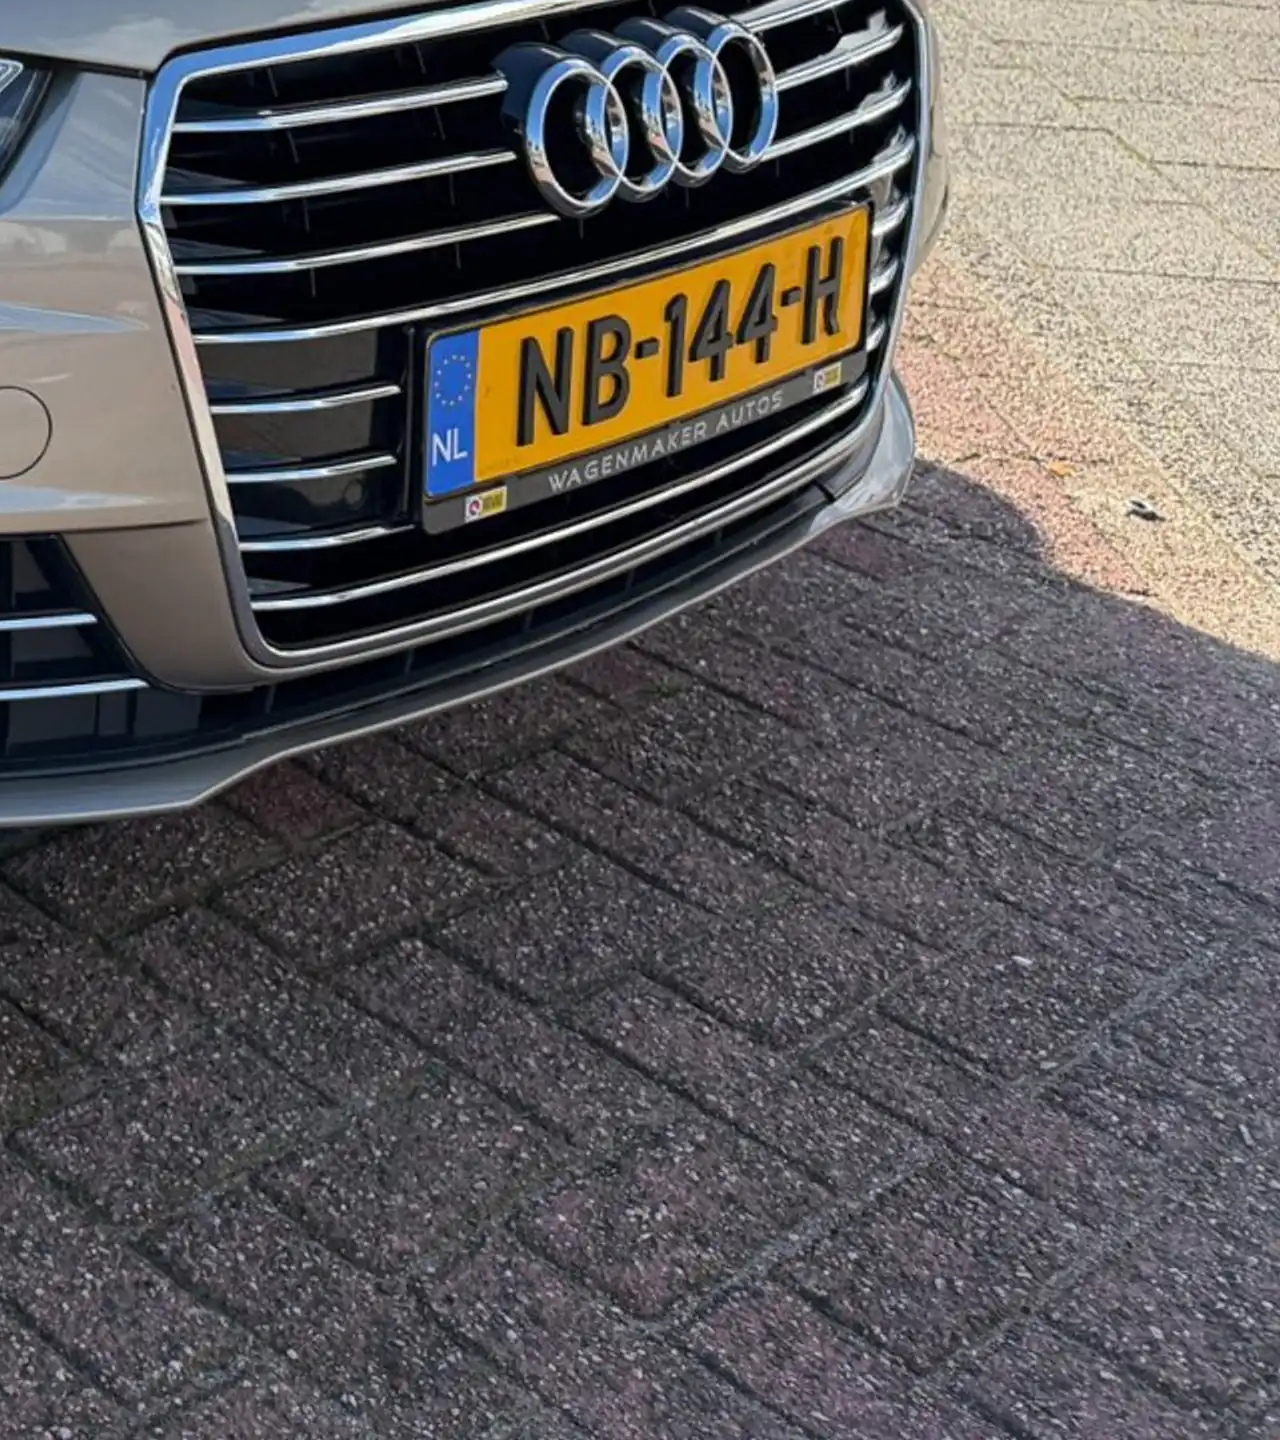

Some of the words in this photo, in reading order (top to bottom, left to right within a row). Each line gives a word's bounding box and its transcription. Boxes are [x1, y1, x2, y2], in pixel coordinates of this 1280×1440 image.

[431, 427, 468, 467] NL
[516, 235, 844, 448] NB-144-H
[547, 421, 709, 494] WAGENMAKER
[715, 390, 784, 434] AUTOS
